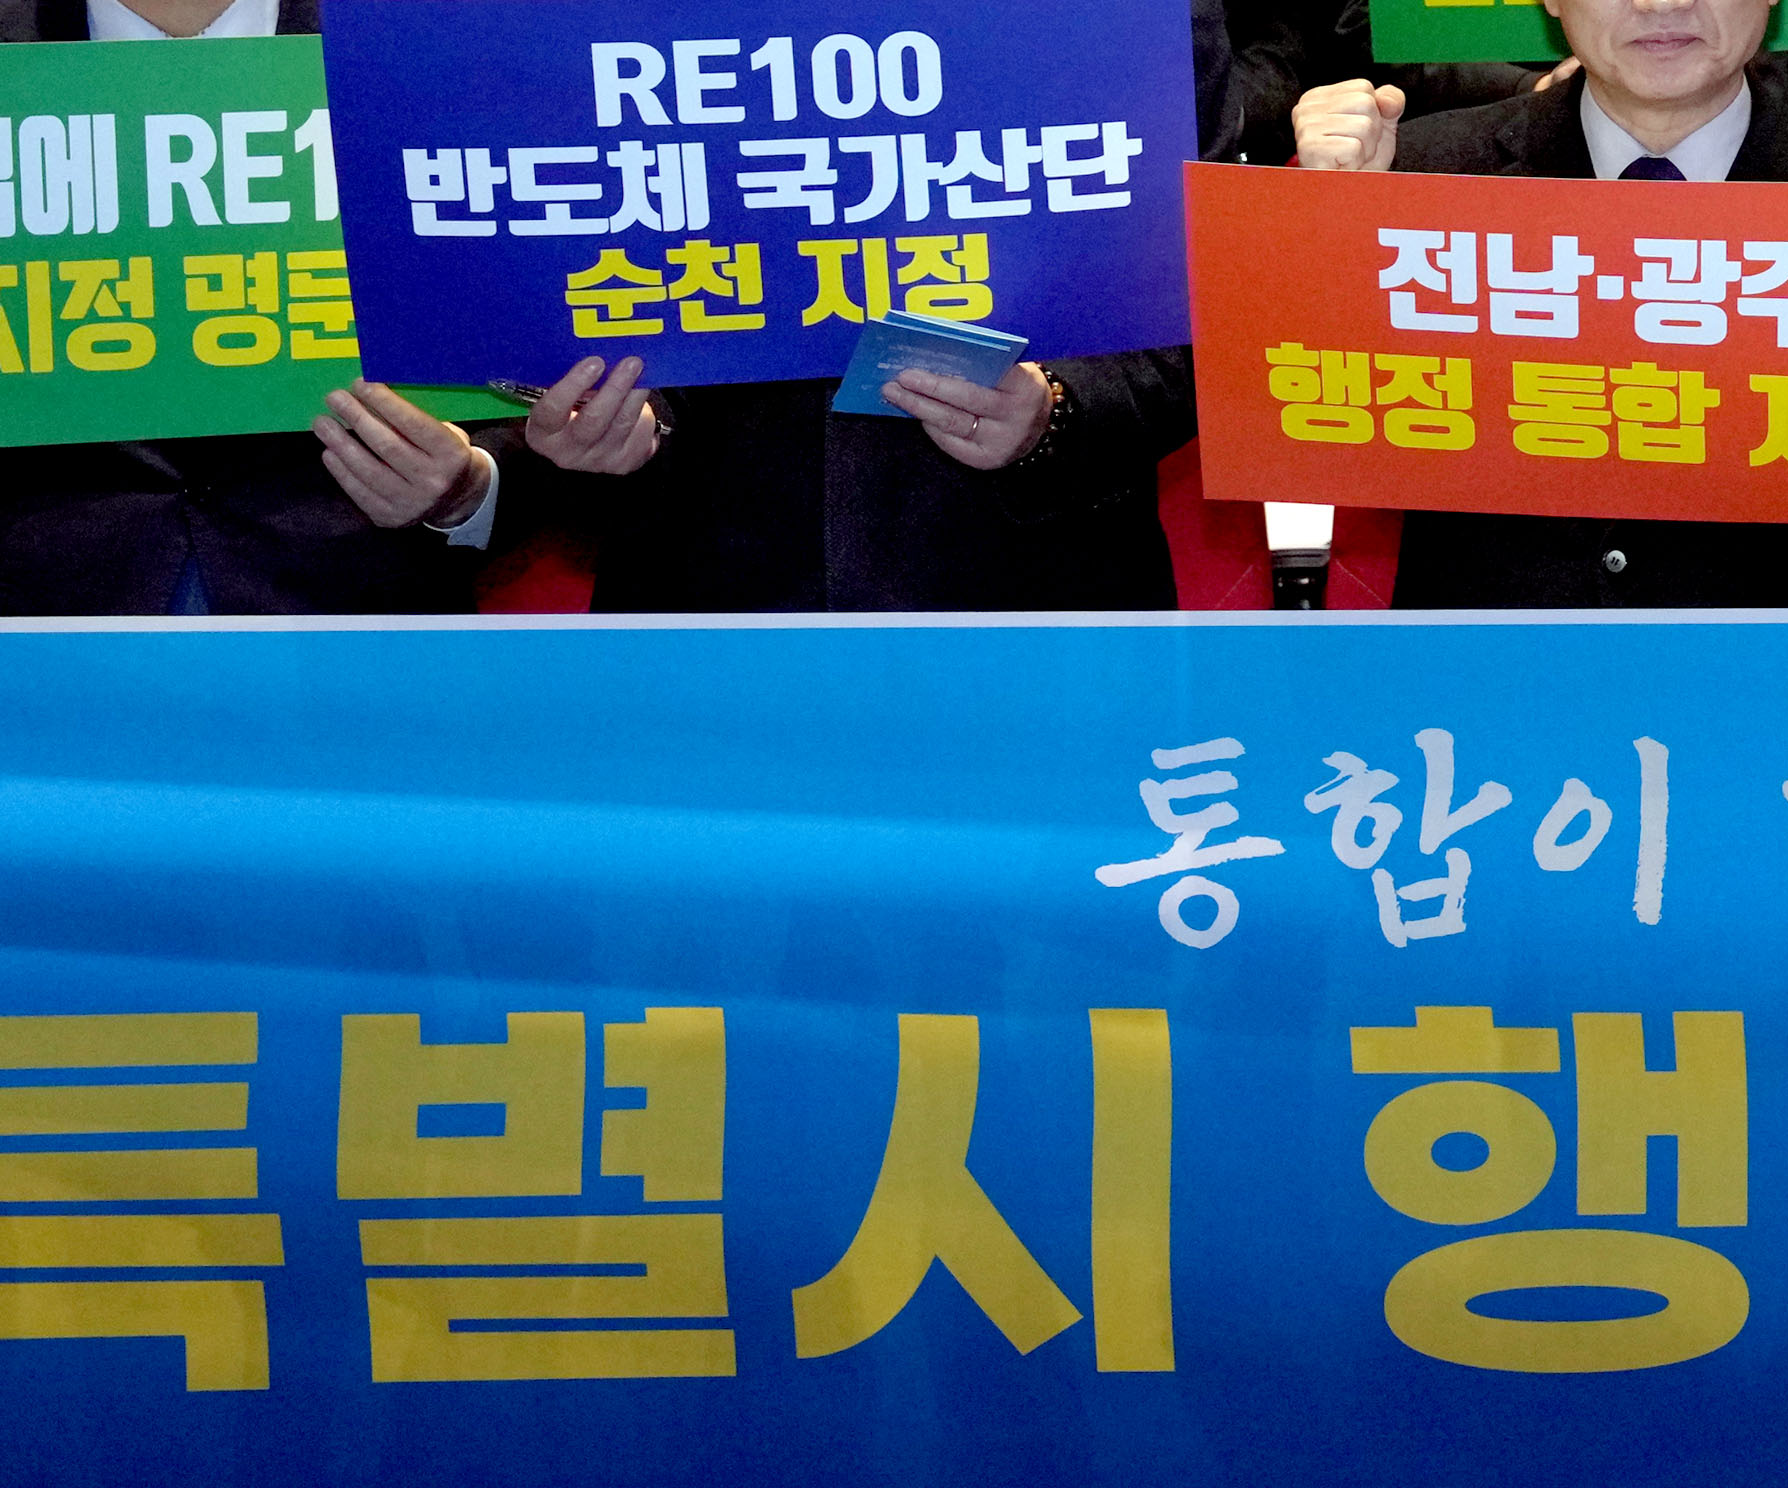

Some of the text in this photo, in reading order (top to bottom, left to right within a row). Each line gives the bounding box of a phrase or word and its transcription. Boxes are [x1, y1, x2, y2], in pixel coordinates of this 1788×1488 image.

[590, 31, 945, 128] RE100
[404, 121, 1144, 239] 반도체 국가산단
[184, 247, 362, 369] 명문
[564, 231, 995, 341] 순천 지정
[1266, 342, 1474, 452] 행정
[1508, 361, 1722, 467] 통합
[1095, 727, 1670, 950] 통합이
[0, 1006, 1178, 1393] 특별시
